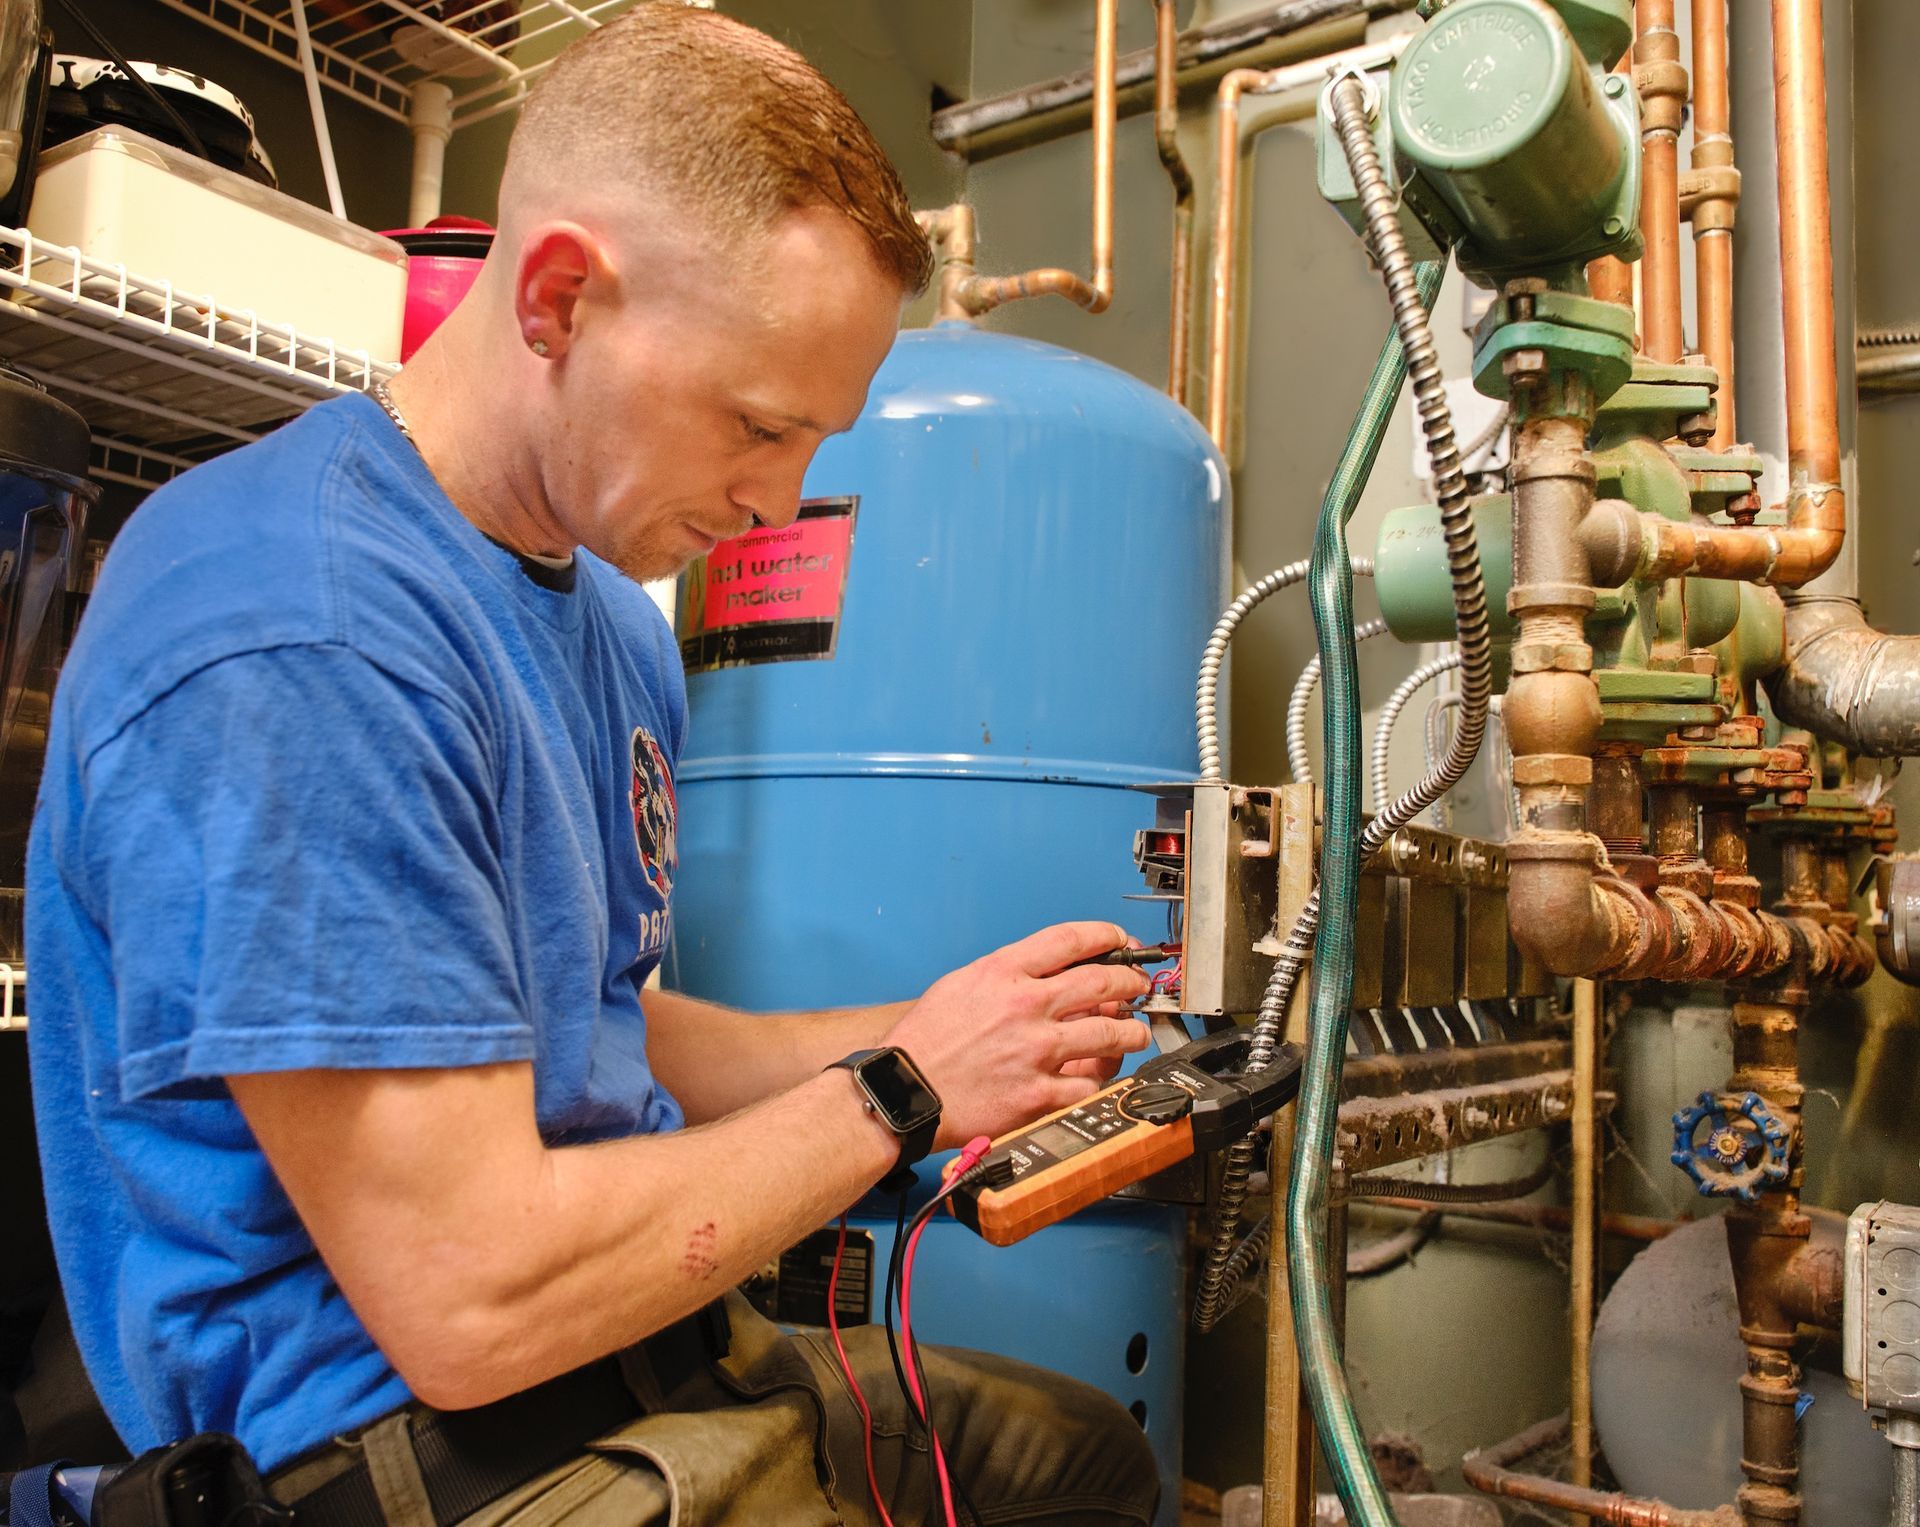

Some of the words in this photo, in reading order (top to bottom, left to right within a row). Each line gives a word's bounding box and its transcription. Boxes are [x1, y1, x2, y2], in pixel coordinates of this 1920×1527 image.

[1431, 14, 1536, 53] CARTRIDGE
[736, 529, 804, 549] commercial
[751, 551, 833, 578] water
[727, 584, 805, 609] maker
